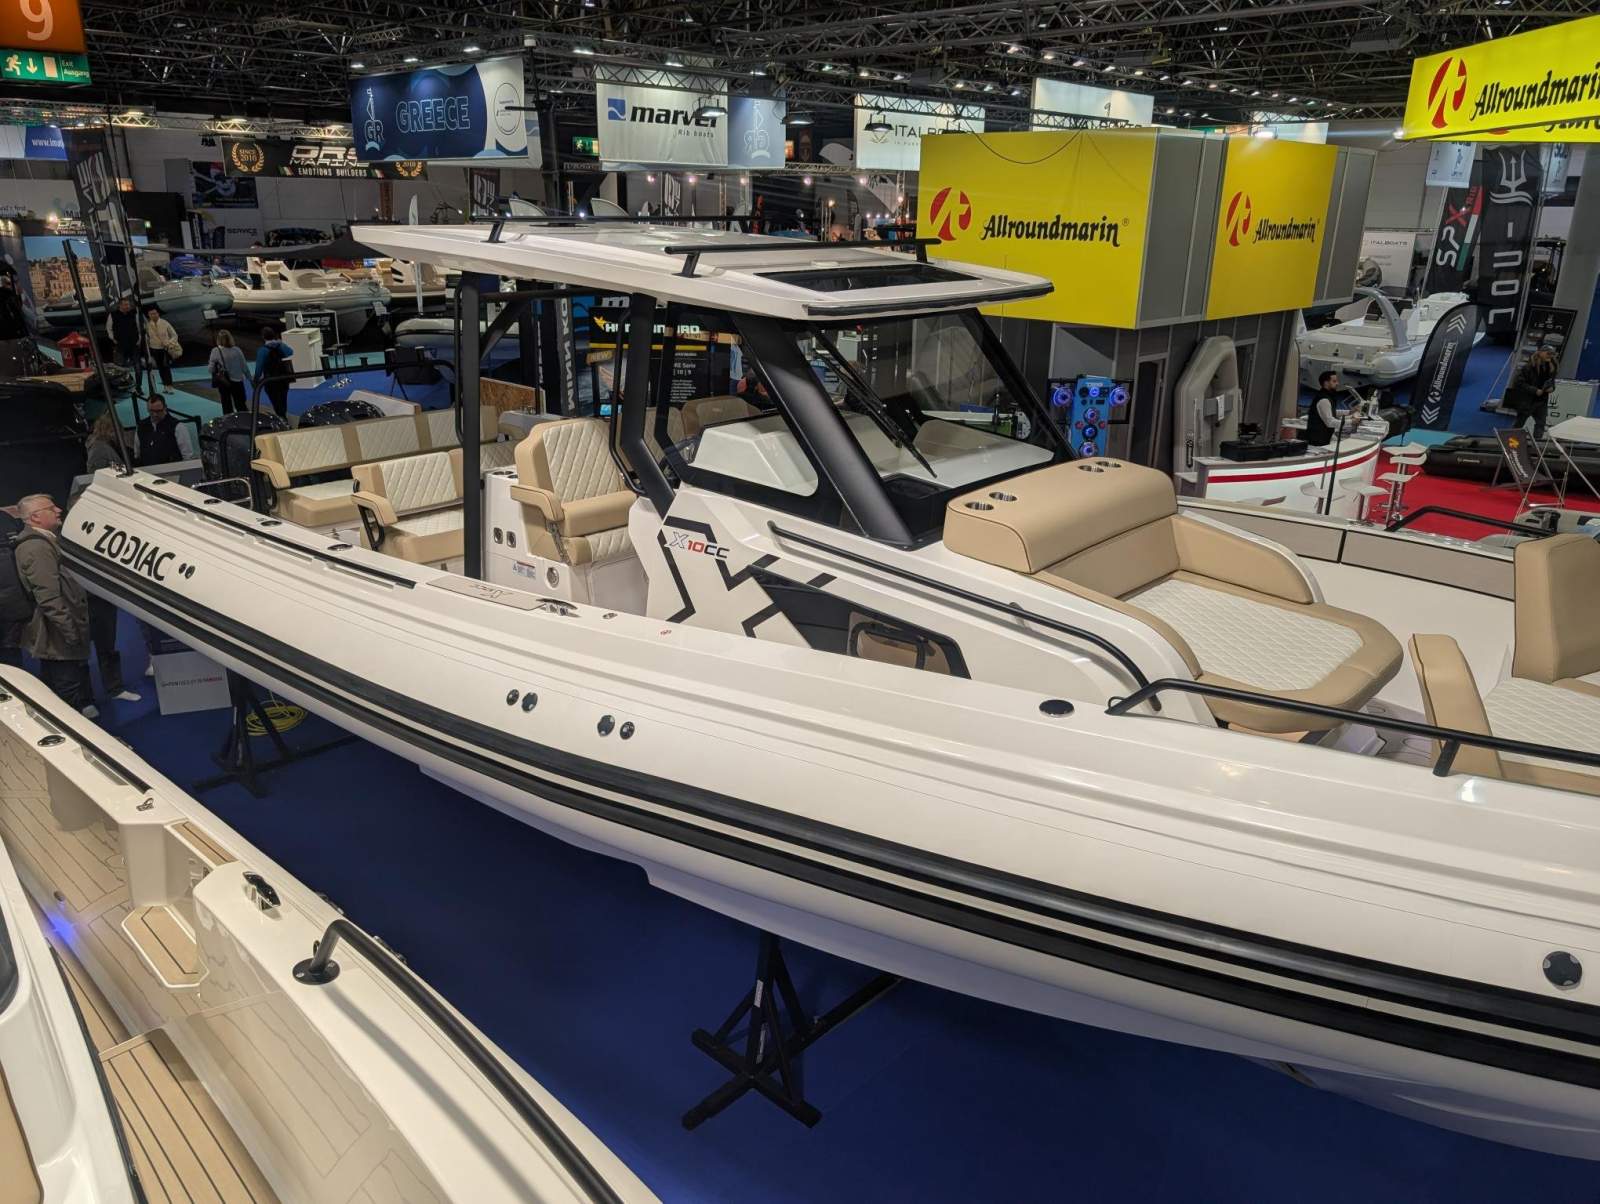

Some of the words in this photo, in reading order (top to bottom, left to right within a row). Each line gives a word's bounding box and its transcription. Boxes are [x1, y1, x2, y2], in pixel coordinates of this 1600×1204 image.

[20, 0, 54, 41] 9
[1471, 65, 1600, 121] Allroundmari
[396, 95, 470, 134] GREECE
[298, 167, 332, 176] EMOTIONS
[336, 168, 367, 177] BUILDERS
[981, 214, 1121, 247] Allroundmarin
[1252, 217, 1316, 244] Allroundmarin
[94, 524, 176, 581] ZODIAC
[669, 531, 730, 559] X10CC
